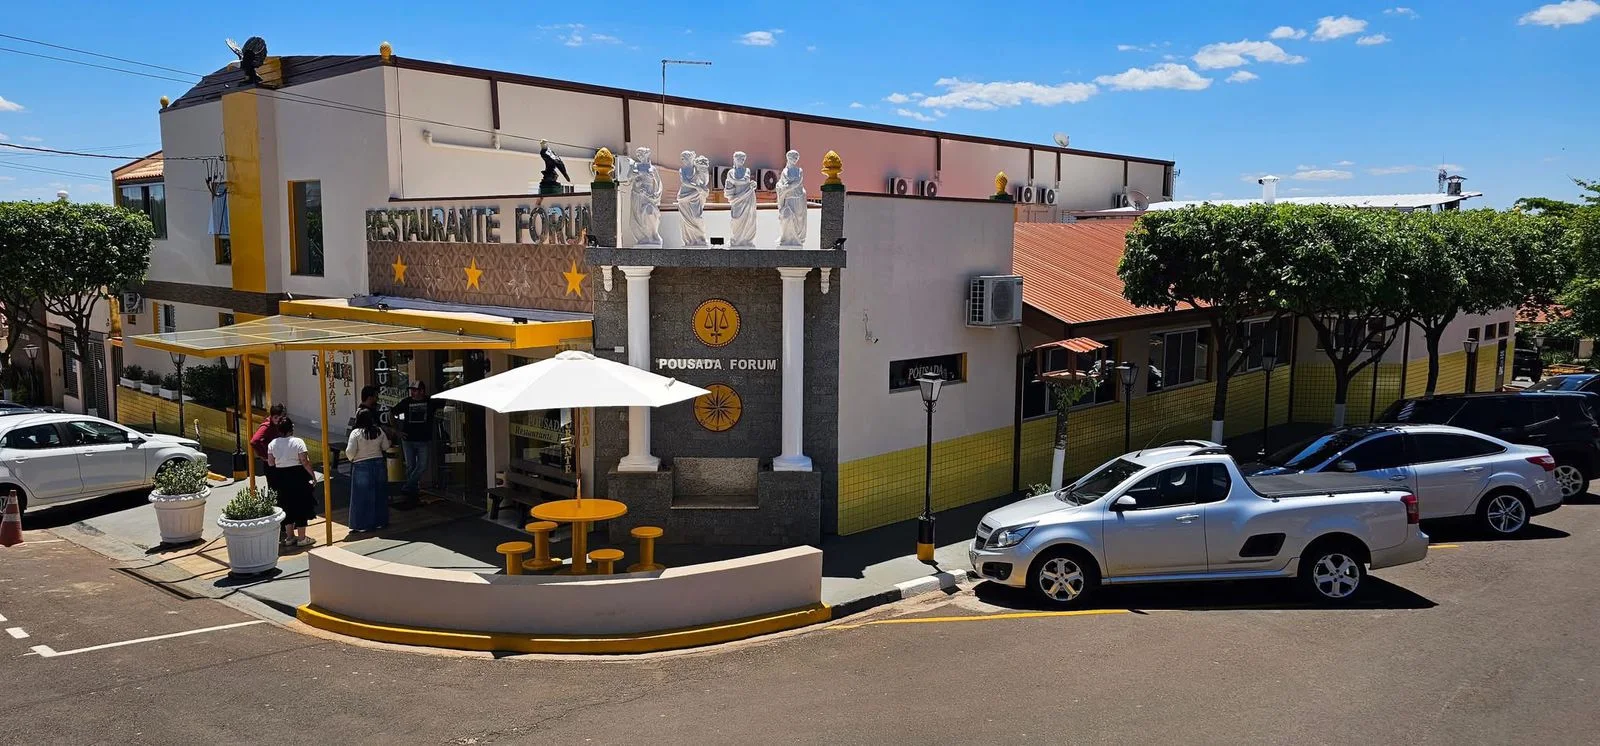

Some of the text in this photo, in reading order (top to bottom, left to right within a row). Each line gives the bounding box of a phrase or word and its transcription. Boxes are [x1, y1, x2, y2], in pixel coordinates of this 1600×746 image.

[366, 207, 501, 243] RESTAURANTE
[658, 358, 777, 371] POUSADA FORUM
